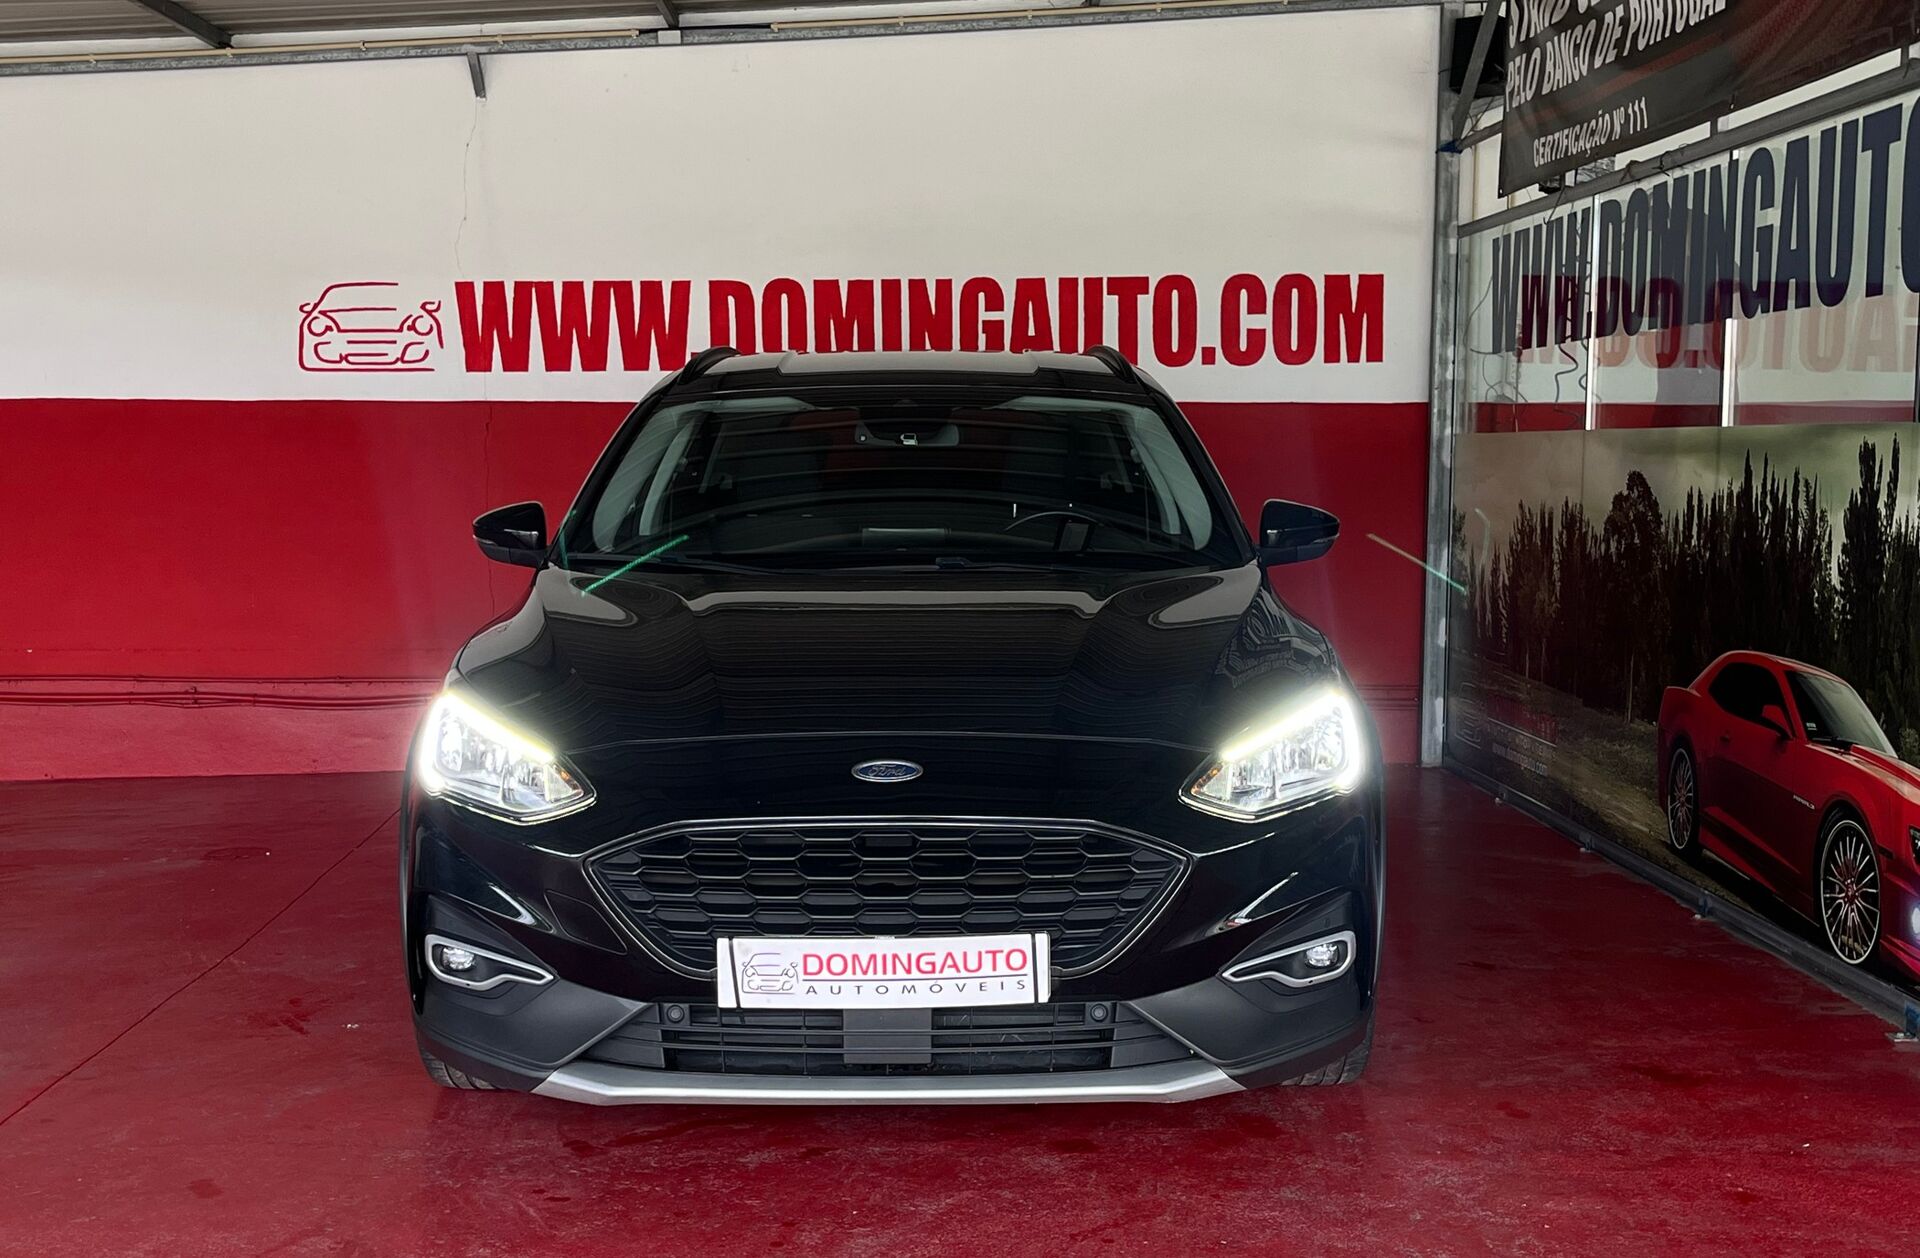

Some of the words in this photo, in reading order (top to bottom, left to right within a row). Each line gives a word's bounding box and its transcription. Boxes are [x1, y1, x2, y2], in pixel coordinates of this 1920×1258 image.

[1506, 47, 1541, 112] PELO
[1542, 19, 1597, 96] BANCO
[1594, 4, 1625, 69] DE
[1622, 0, 1727, 57] PORTUG
[1533, 109, 1610, 168] CERTIFICAÇÃO
[1628, 96, 1649, 135] 111
[454, 272, 1384, 372] WWWDOMINGAUTO.COM
[868, 764, 906, 777] Ford
[803, 948, 1028, 977] DOMINGAUTO
